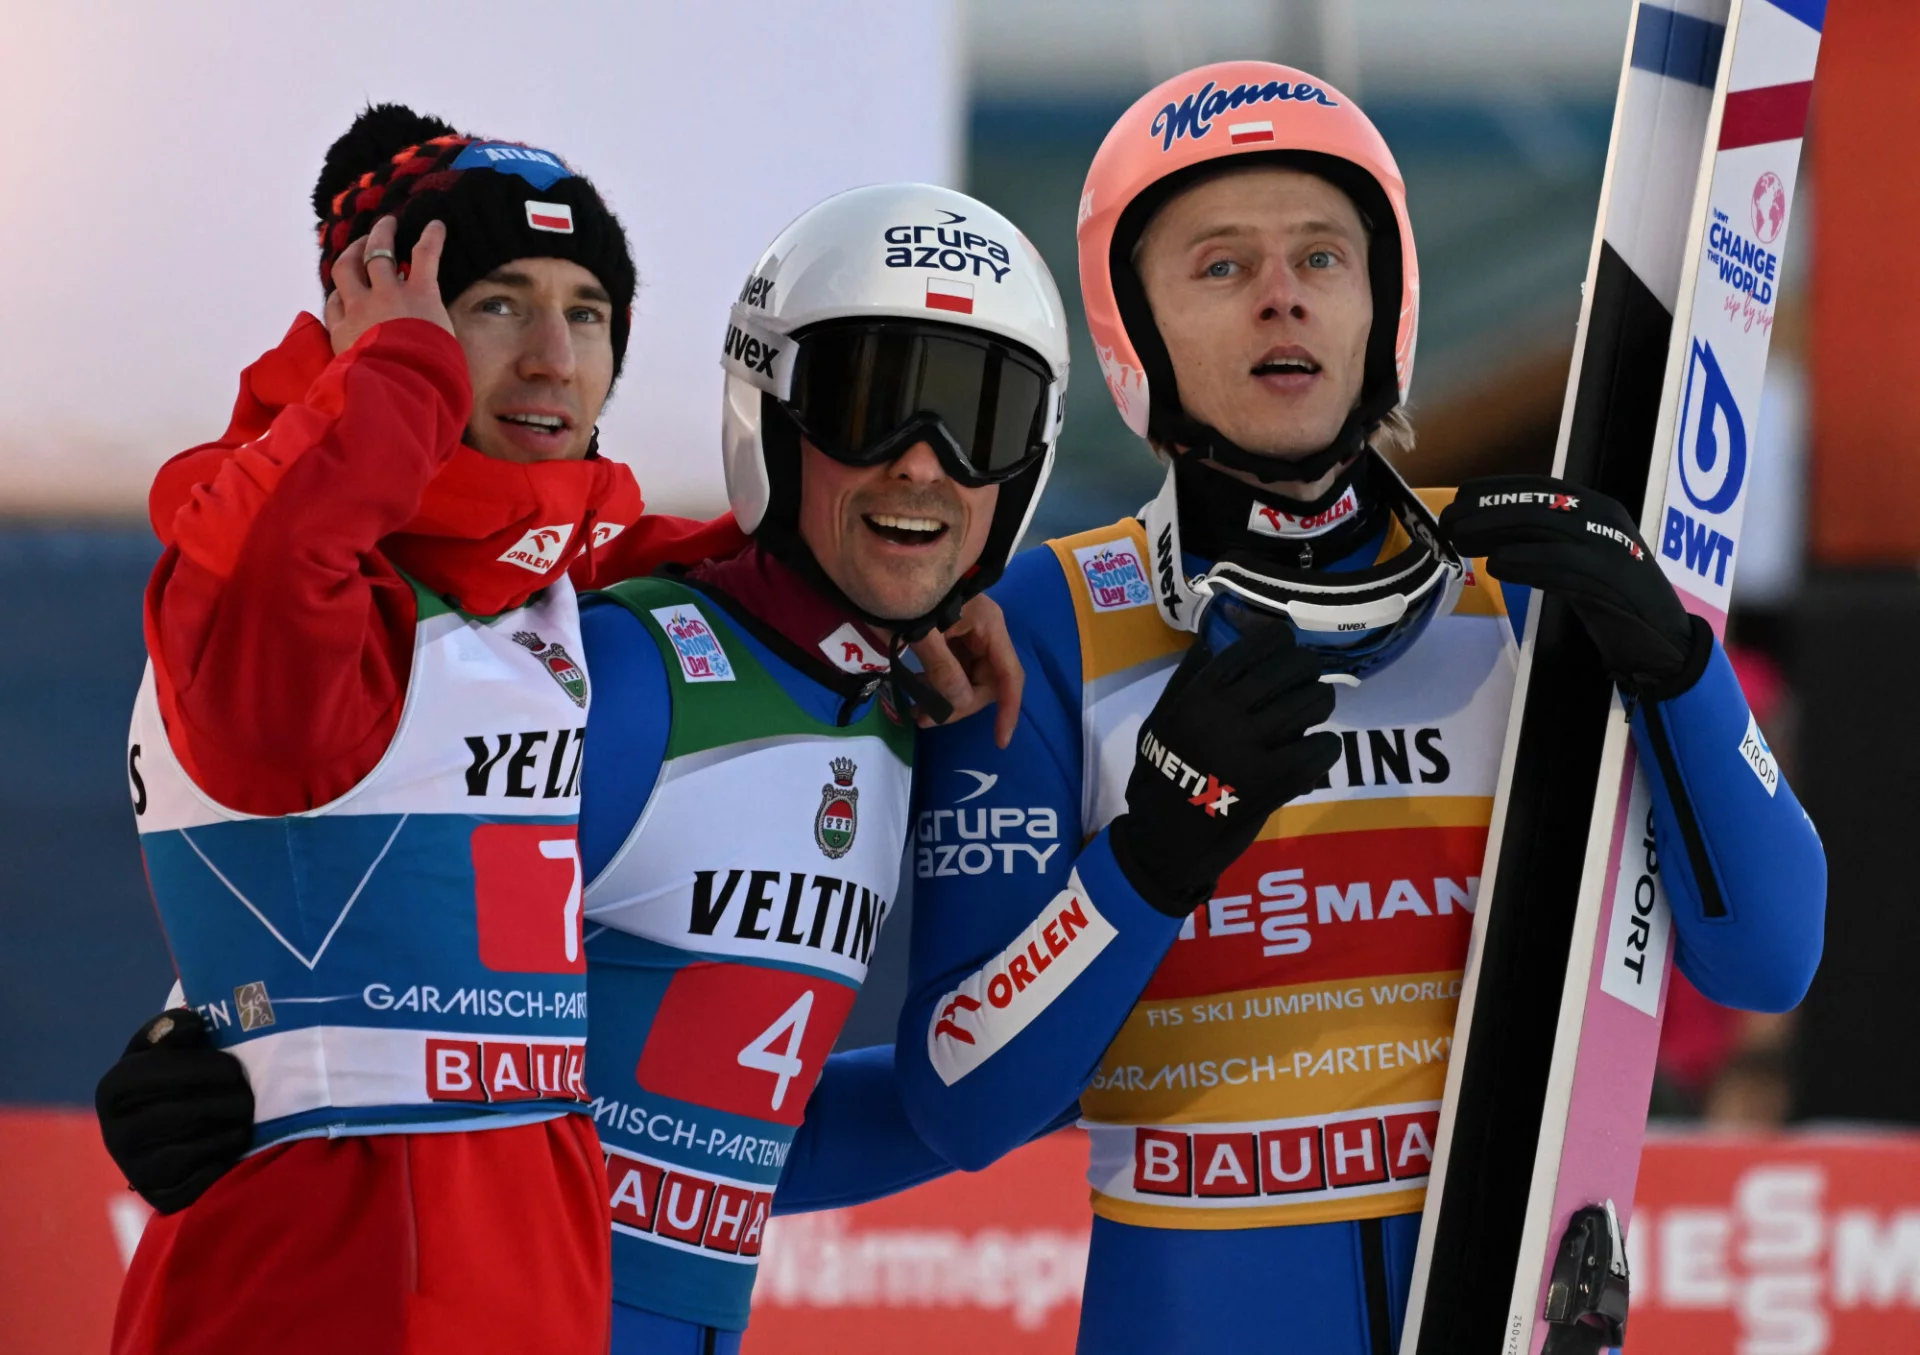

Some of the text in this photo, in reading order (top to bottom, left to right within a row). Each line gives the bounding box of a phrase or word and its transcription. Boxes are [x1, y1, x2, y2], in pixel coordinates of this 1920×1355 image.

[1151, 80, 1339, 152] Manner
[1707, 249, 1772, 305] THE WORLD
[1709, 222, 1777, 282] CHANGE
[724, 323, 780, 380] uvex
[1300, 494, 1353, 530] ORLEN
[506, 550, 553, 569] ORLEN
[1092, 553, 1132, 573] World
[1157, 521, 1183, 621] uvex
[1661, 506, 1735, 588] BWT
[1087, 564, 1138, 590] Snow
[1099, 586, 1126, 604] Day
[1337, 621, 1367, 631] uvex
[686, 655, 711, 674] Day
[1313, 728, 1451, 790] INS
[1743, 734, 1776, 784] KROP
[539, 839, 583, 963] 7
[987, 896, 1090, 1010] ORLEN
[1146, 980, 1462, 1028] FIS SKI JUMPING WORLD
[737, 990, 815, 1112] 4
